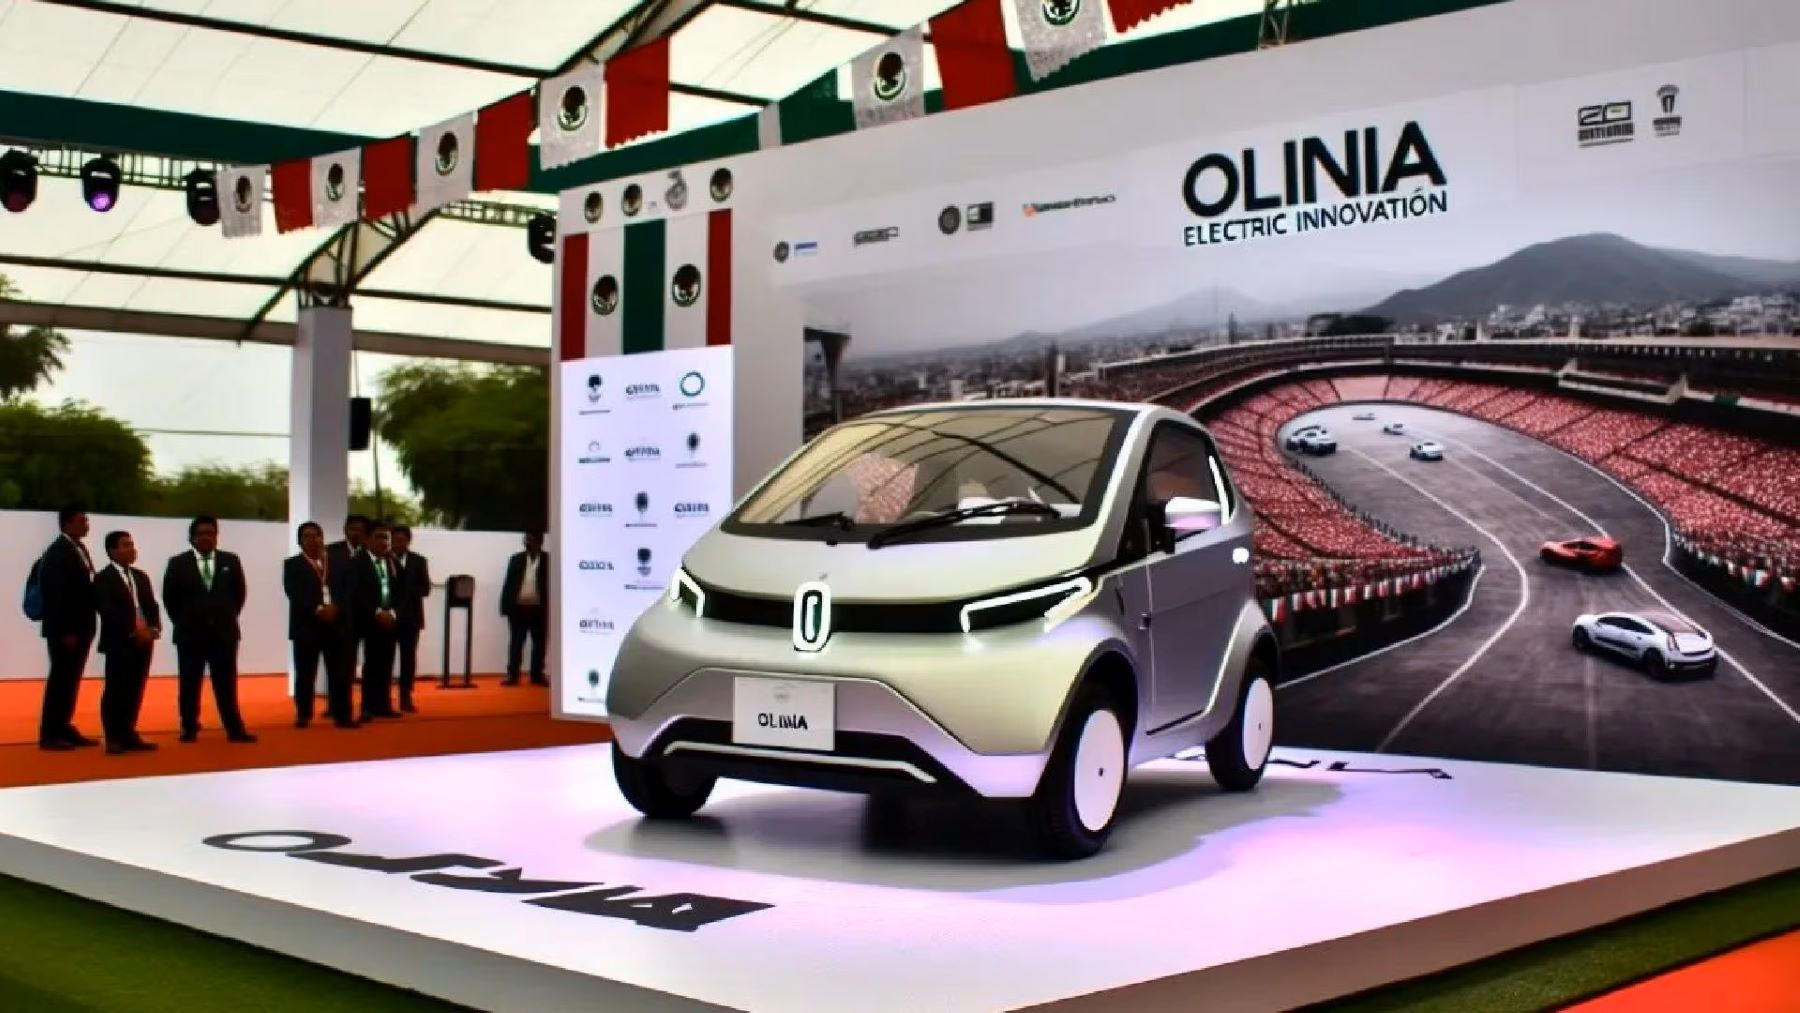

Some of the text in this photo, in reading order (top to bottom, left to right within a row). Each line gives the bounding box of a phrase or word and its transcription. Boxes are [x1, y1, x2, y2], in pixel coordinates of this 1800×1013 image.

[1183, 120, 1448, 218] OLINIA
[1184, 187, 1448, 247] ELECTRIC INNOVATIÓN
